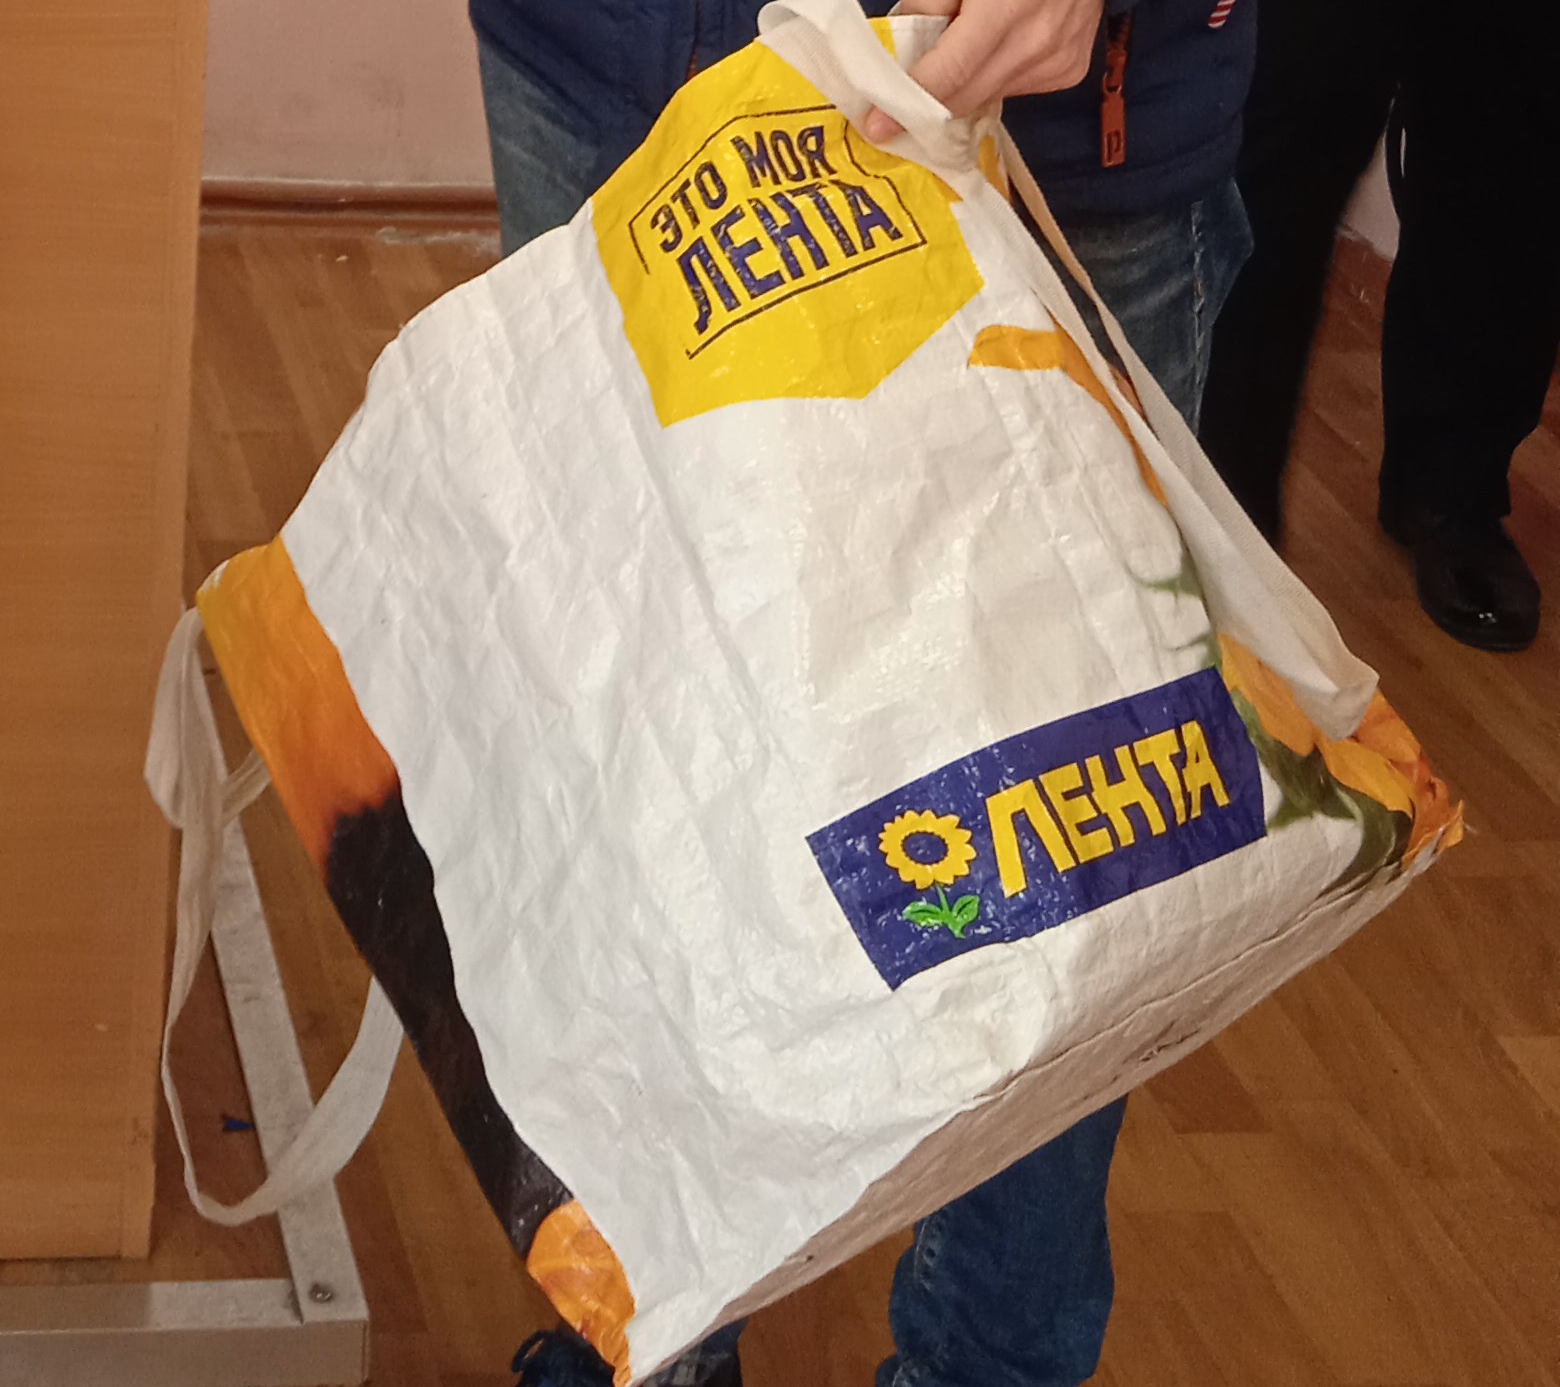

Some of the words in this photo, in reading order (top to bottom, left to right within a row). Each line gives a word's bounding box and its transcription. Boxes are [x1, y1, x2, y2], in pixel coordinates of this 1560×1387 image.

[649, 161, 728, 254] ЭТО
[730, 124, 839, 188] МОЯ
[676, 179, 904, 336] ЛЕНТА
[985, 720, 1230, 899] ЛЕНТА
